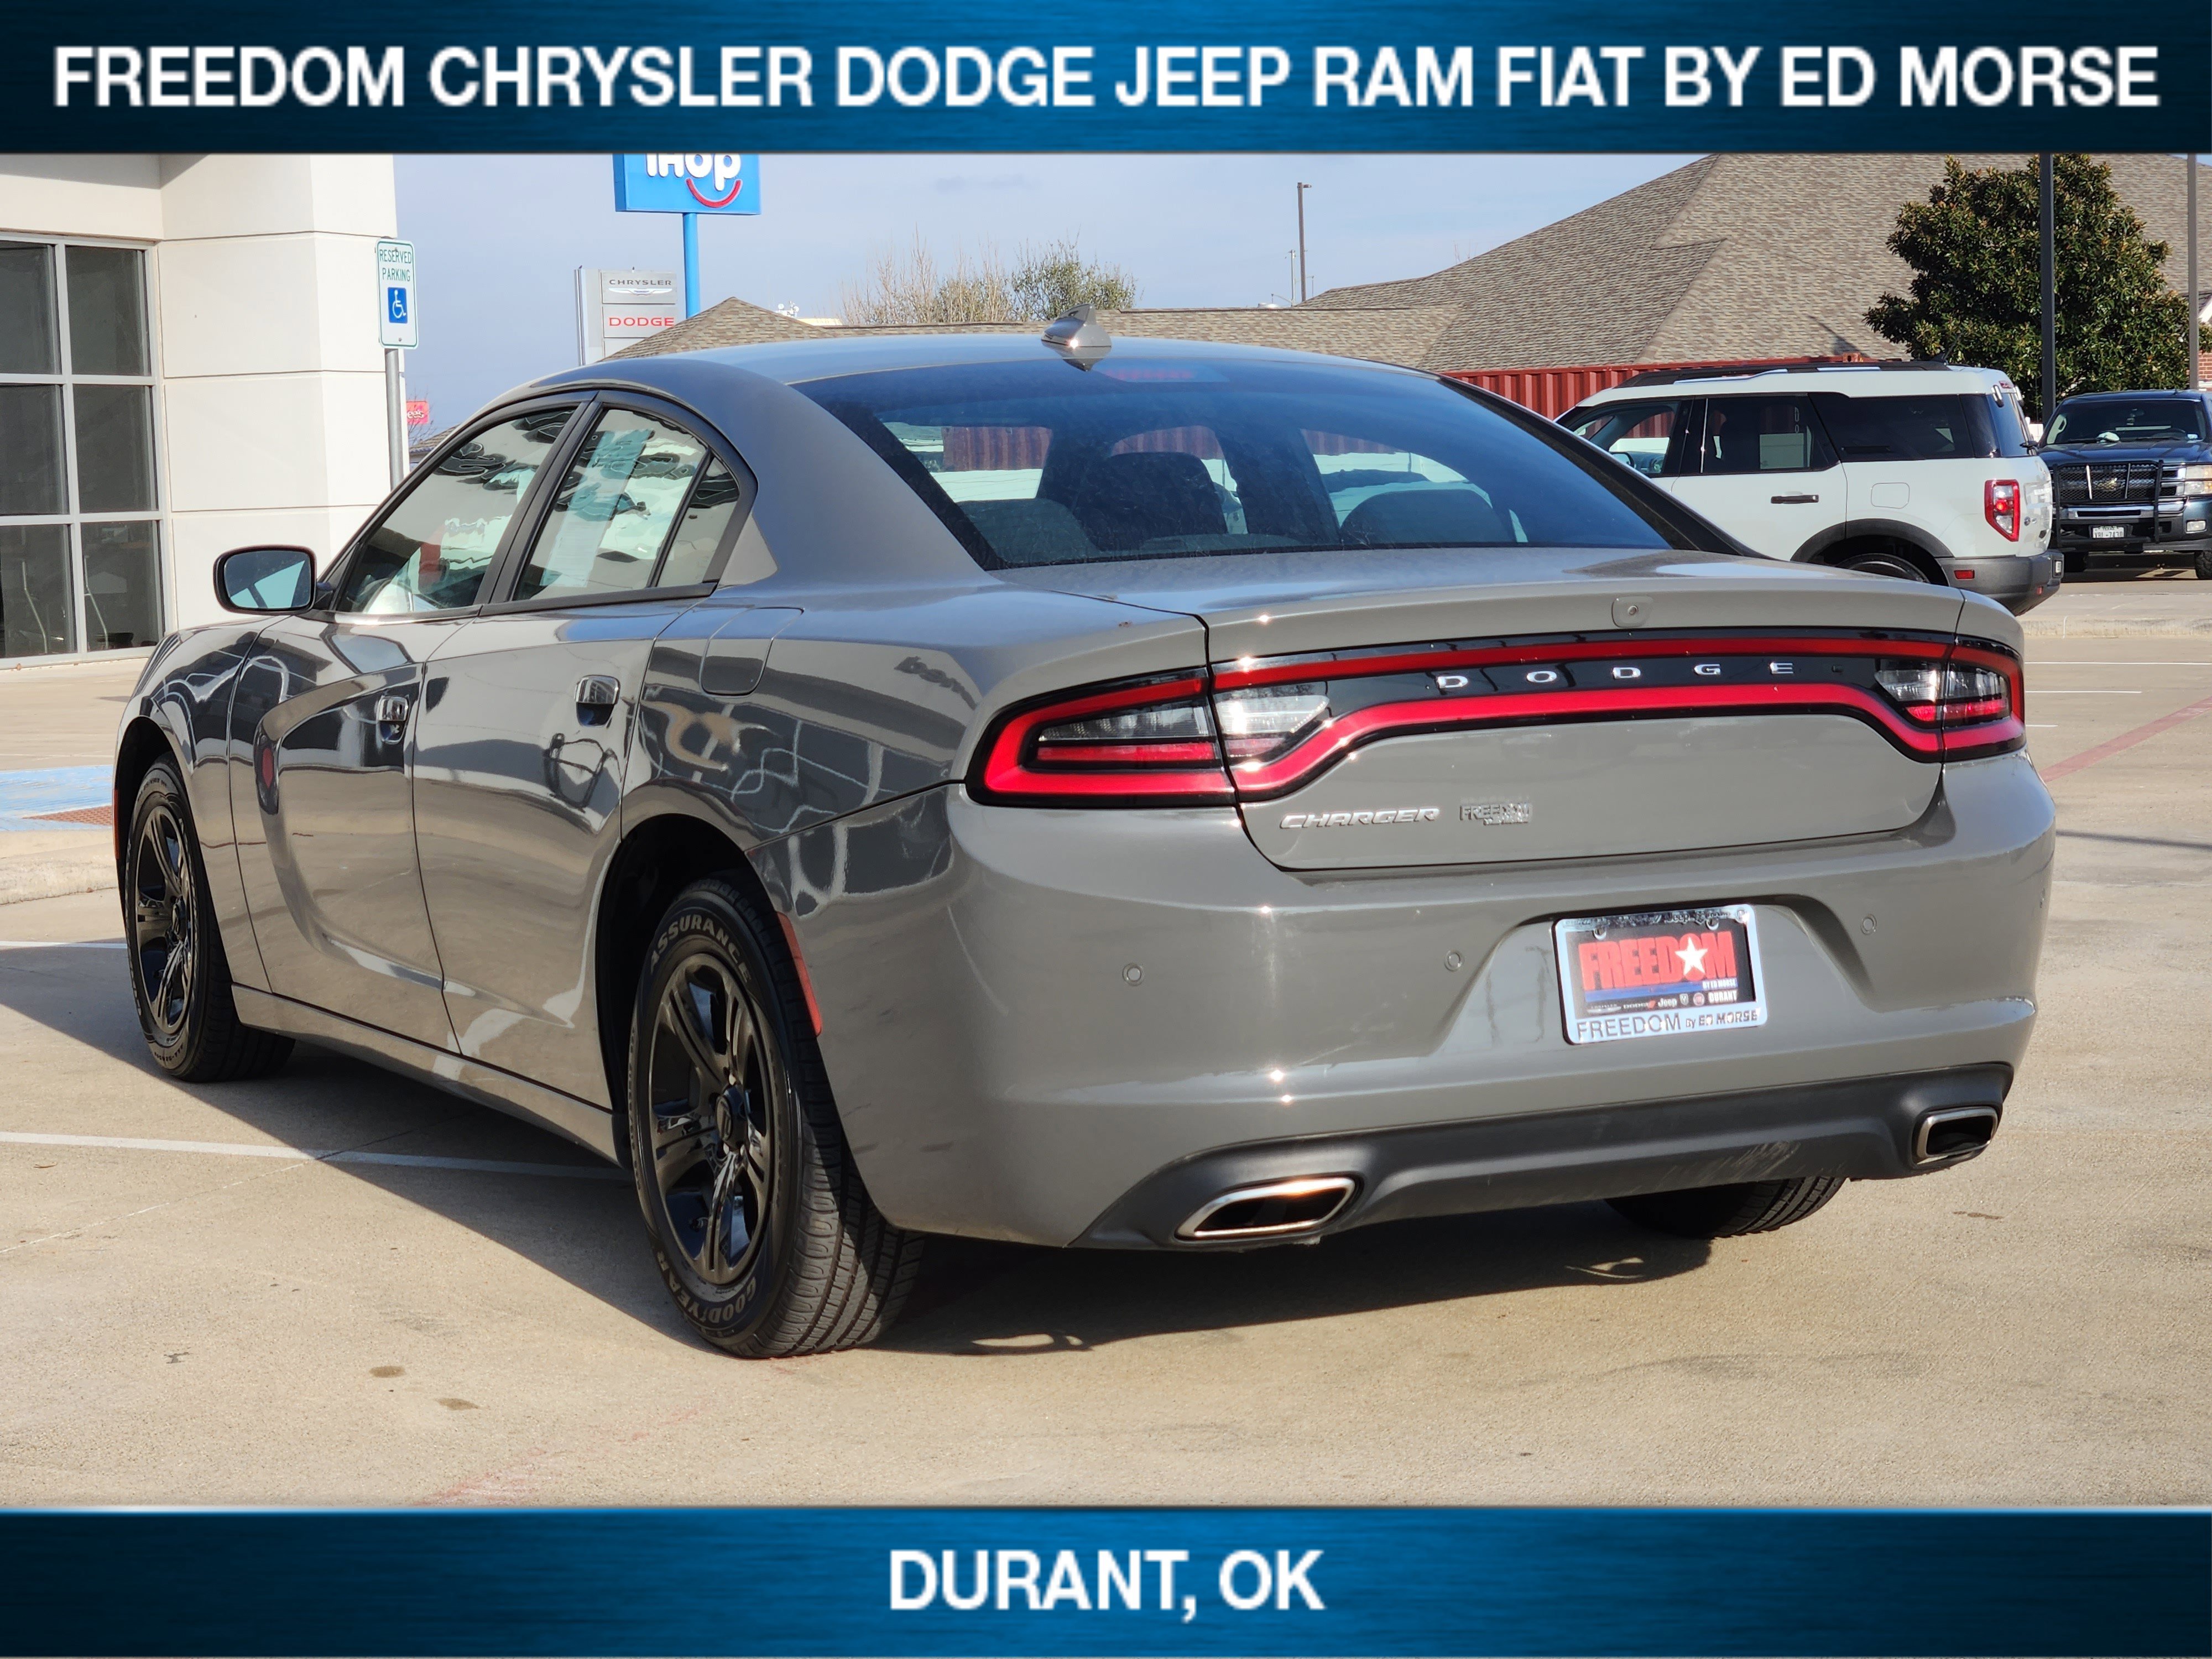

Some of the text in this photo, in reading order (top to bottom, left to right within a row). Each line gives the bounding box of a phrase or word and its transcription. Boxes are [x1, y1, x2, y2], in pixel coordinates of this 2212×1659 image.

[379, 249, 412, 264] RESERVED
[382, 268, 410, 281] PARKING
[609, 317, 675, 327] DODGE
[1437, 661, 1794, 689] DODGE
[1279, 806, 1440, 830] CHARGER
[650, 914, 752, 983] ASSURANCE
[1578, 931, 1738, 991] FREEDOM
[1718, 978, 1736, 988] MORSE
[1657, 997, 1678, 1008] Jeep
[1708, 989, 1738, 1004] DURANT
[1576, 1012, 1681, 1041] FREEDOM
[1698, 1014, 1714, 1026] ED
[1717, 1009, 1758, 1025] MORSE
[656, 1250, 757, 1324] GOODYEAR
